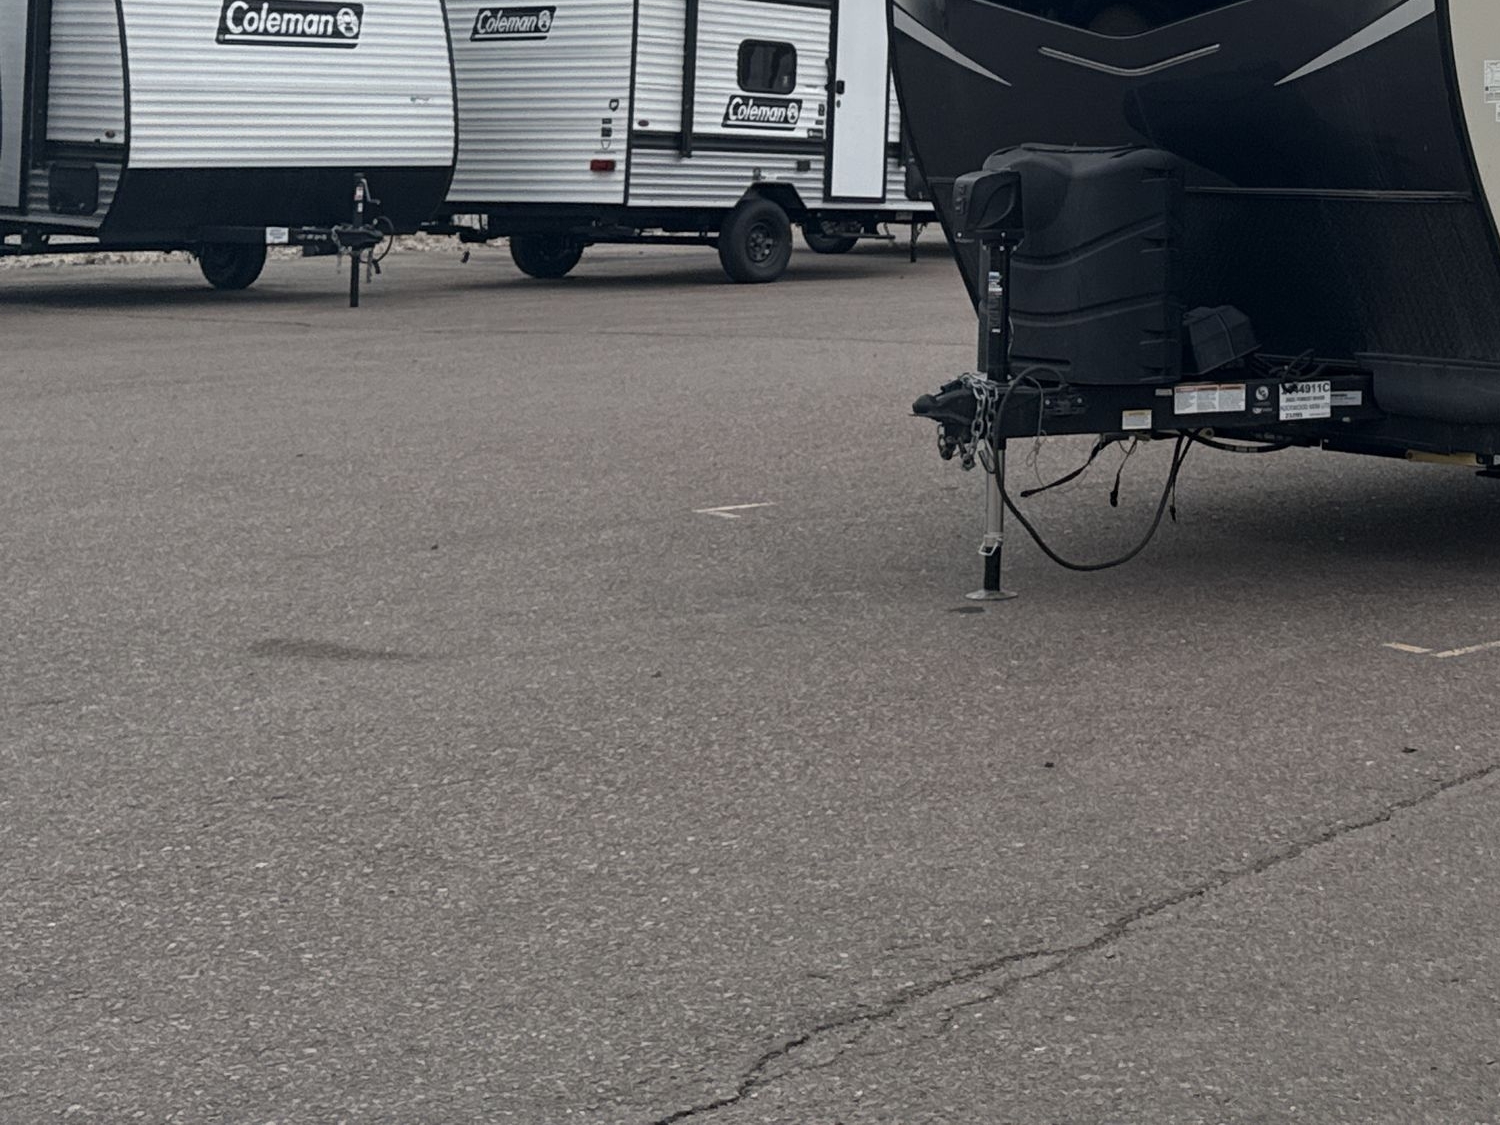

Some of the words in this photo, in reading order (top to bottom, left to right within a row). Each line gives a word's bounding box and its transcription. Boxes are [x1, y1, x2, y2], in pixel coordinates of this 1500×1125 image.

[226, 0, 334, 35] Coleman
[477, 10, 537, 34] Coleman
[729, 97, 786, 121] Coleman
